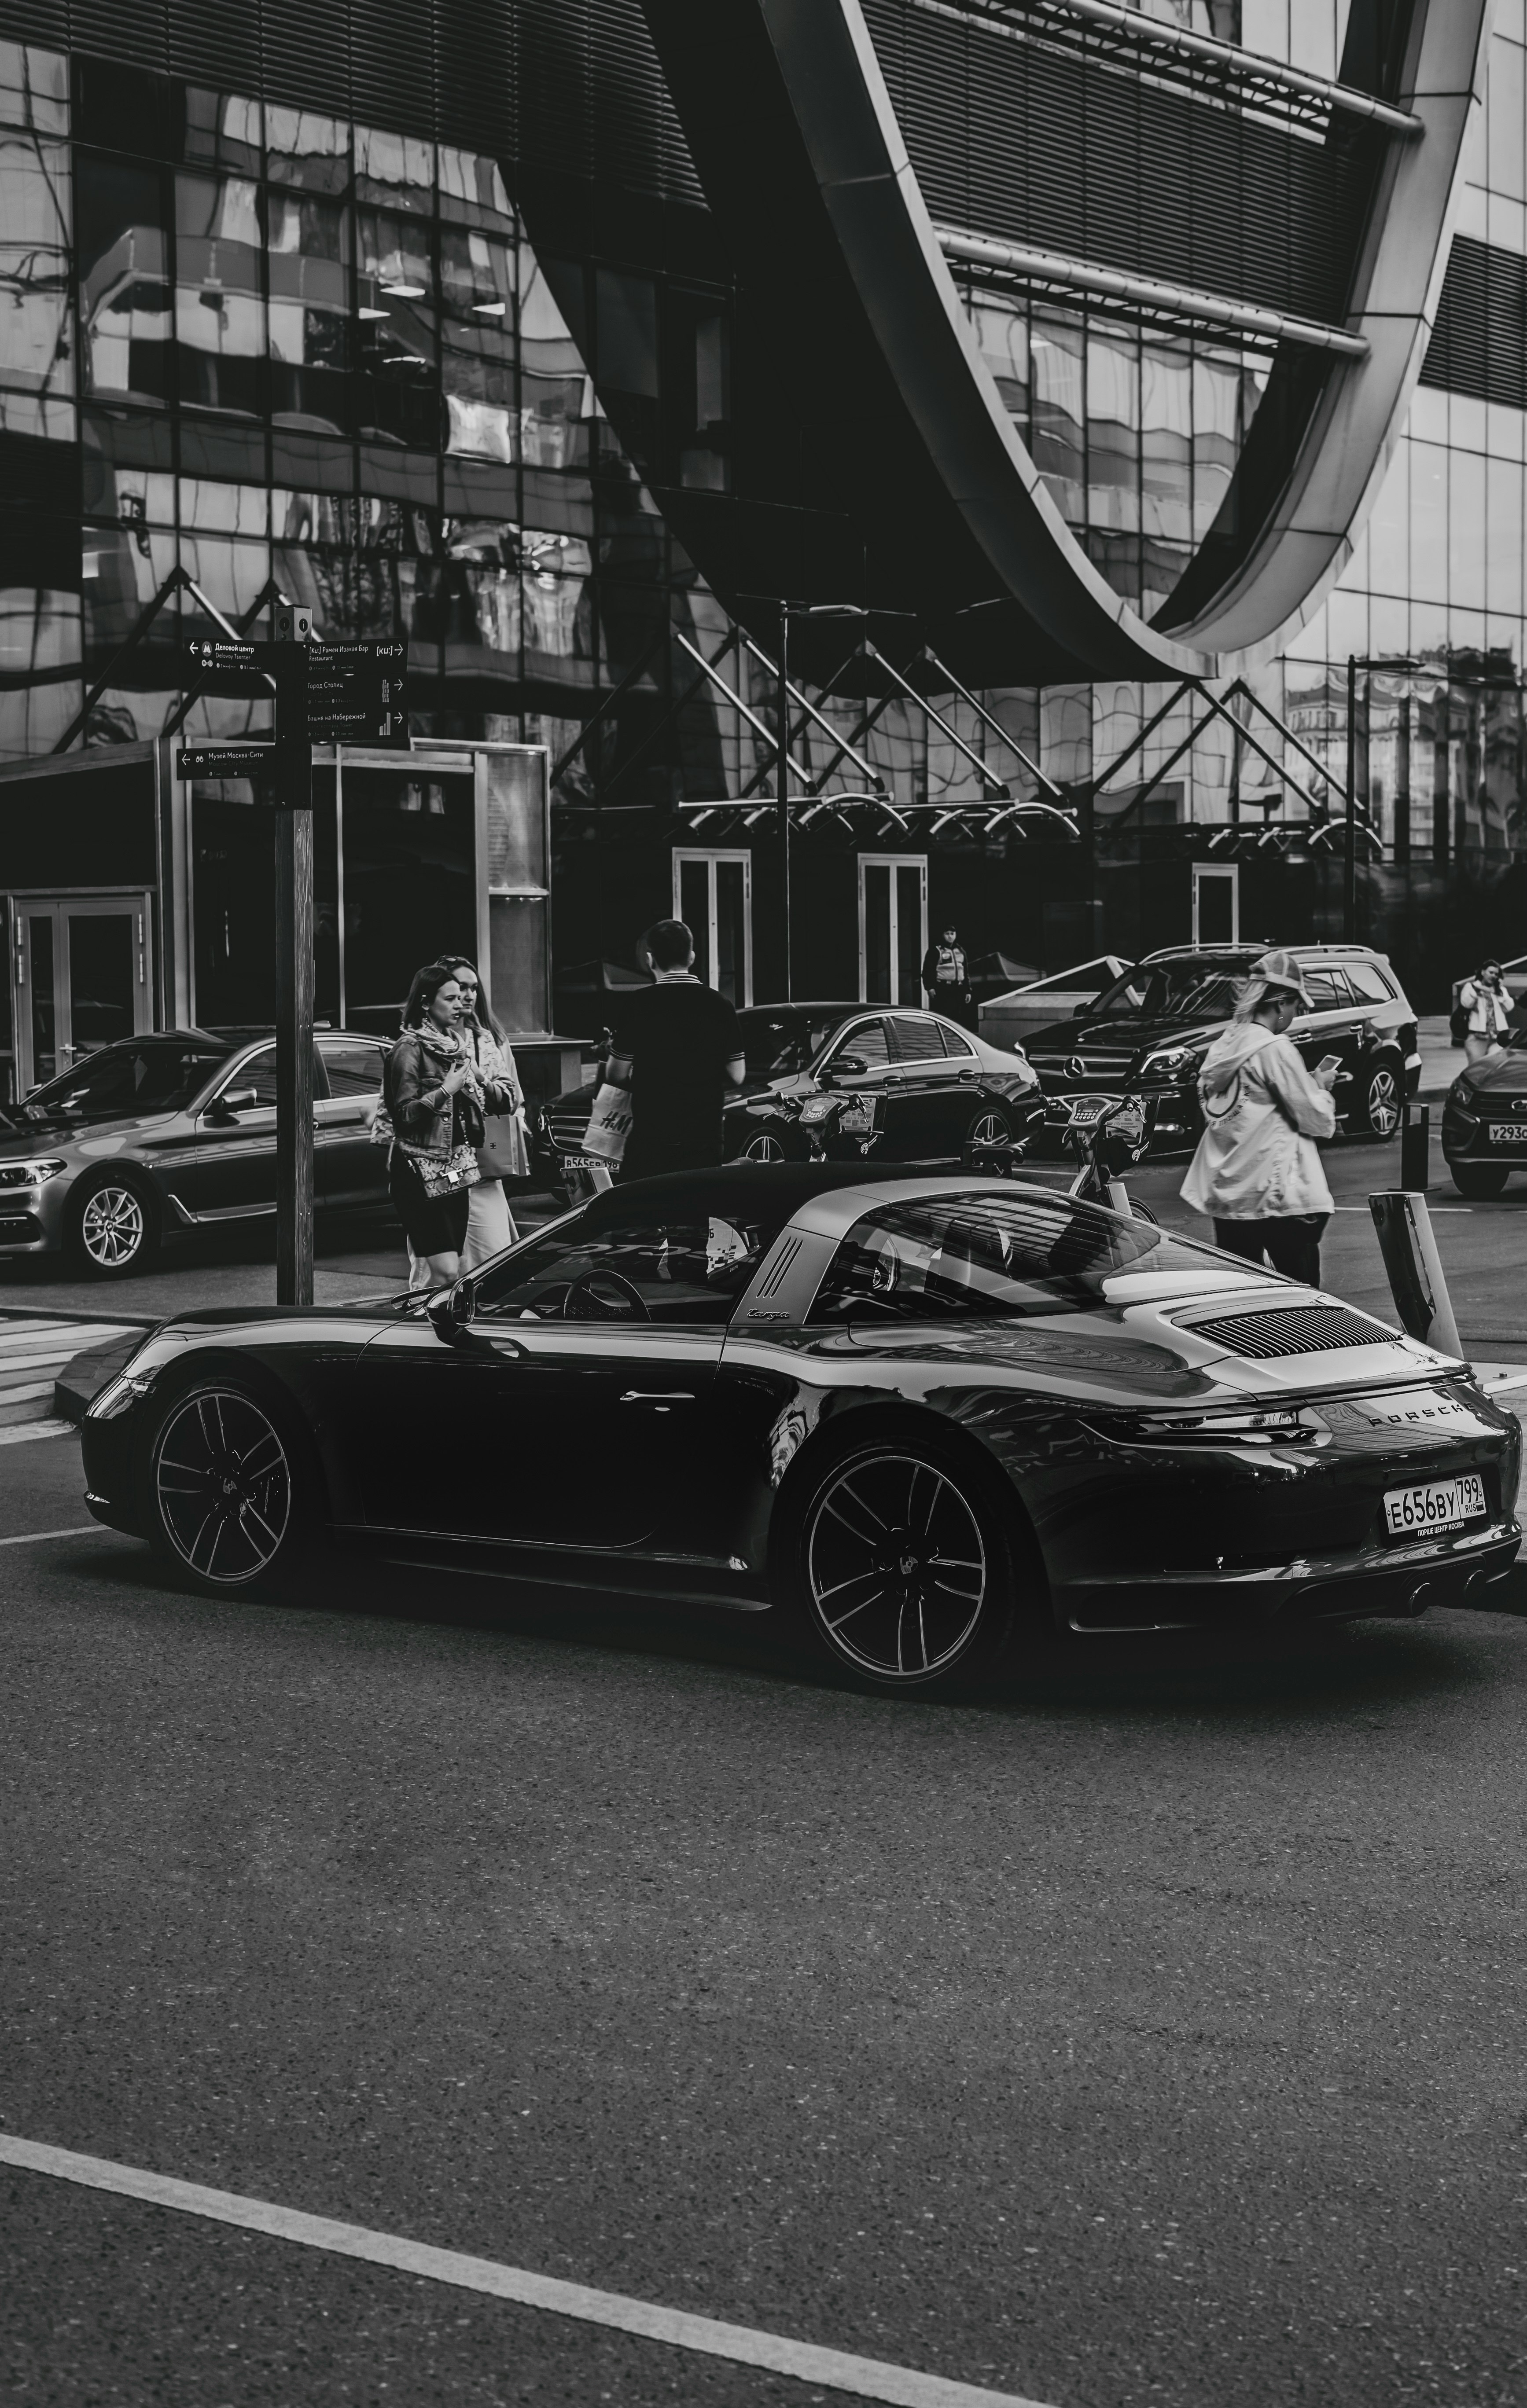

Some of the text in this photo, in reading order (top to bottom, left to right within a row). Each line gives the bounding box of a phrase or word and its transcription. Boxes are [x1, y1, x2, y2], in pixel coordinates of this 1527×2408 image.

[215, 643, 238, 652] Деловой
[359, 645, 368, 653] Бар
[332, 712, 366, 722] Набережной
[208, 752, 226, 760] Музей
[599, 1110, 633, 1135] H&M
[1368, 1401, 1477, 1427] PORSCHE
[1456, 1477, 1479, 1505] 799
[1465, 1501, 1476, 1514] RUS
[1417, 1520, 1465, 1537] ПОРШЕ ЦЕНТР МОСКВА
